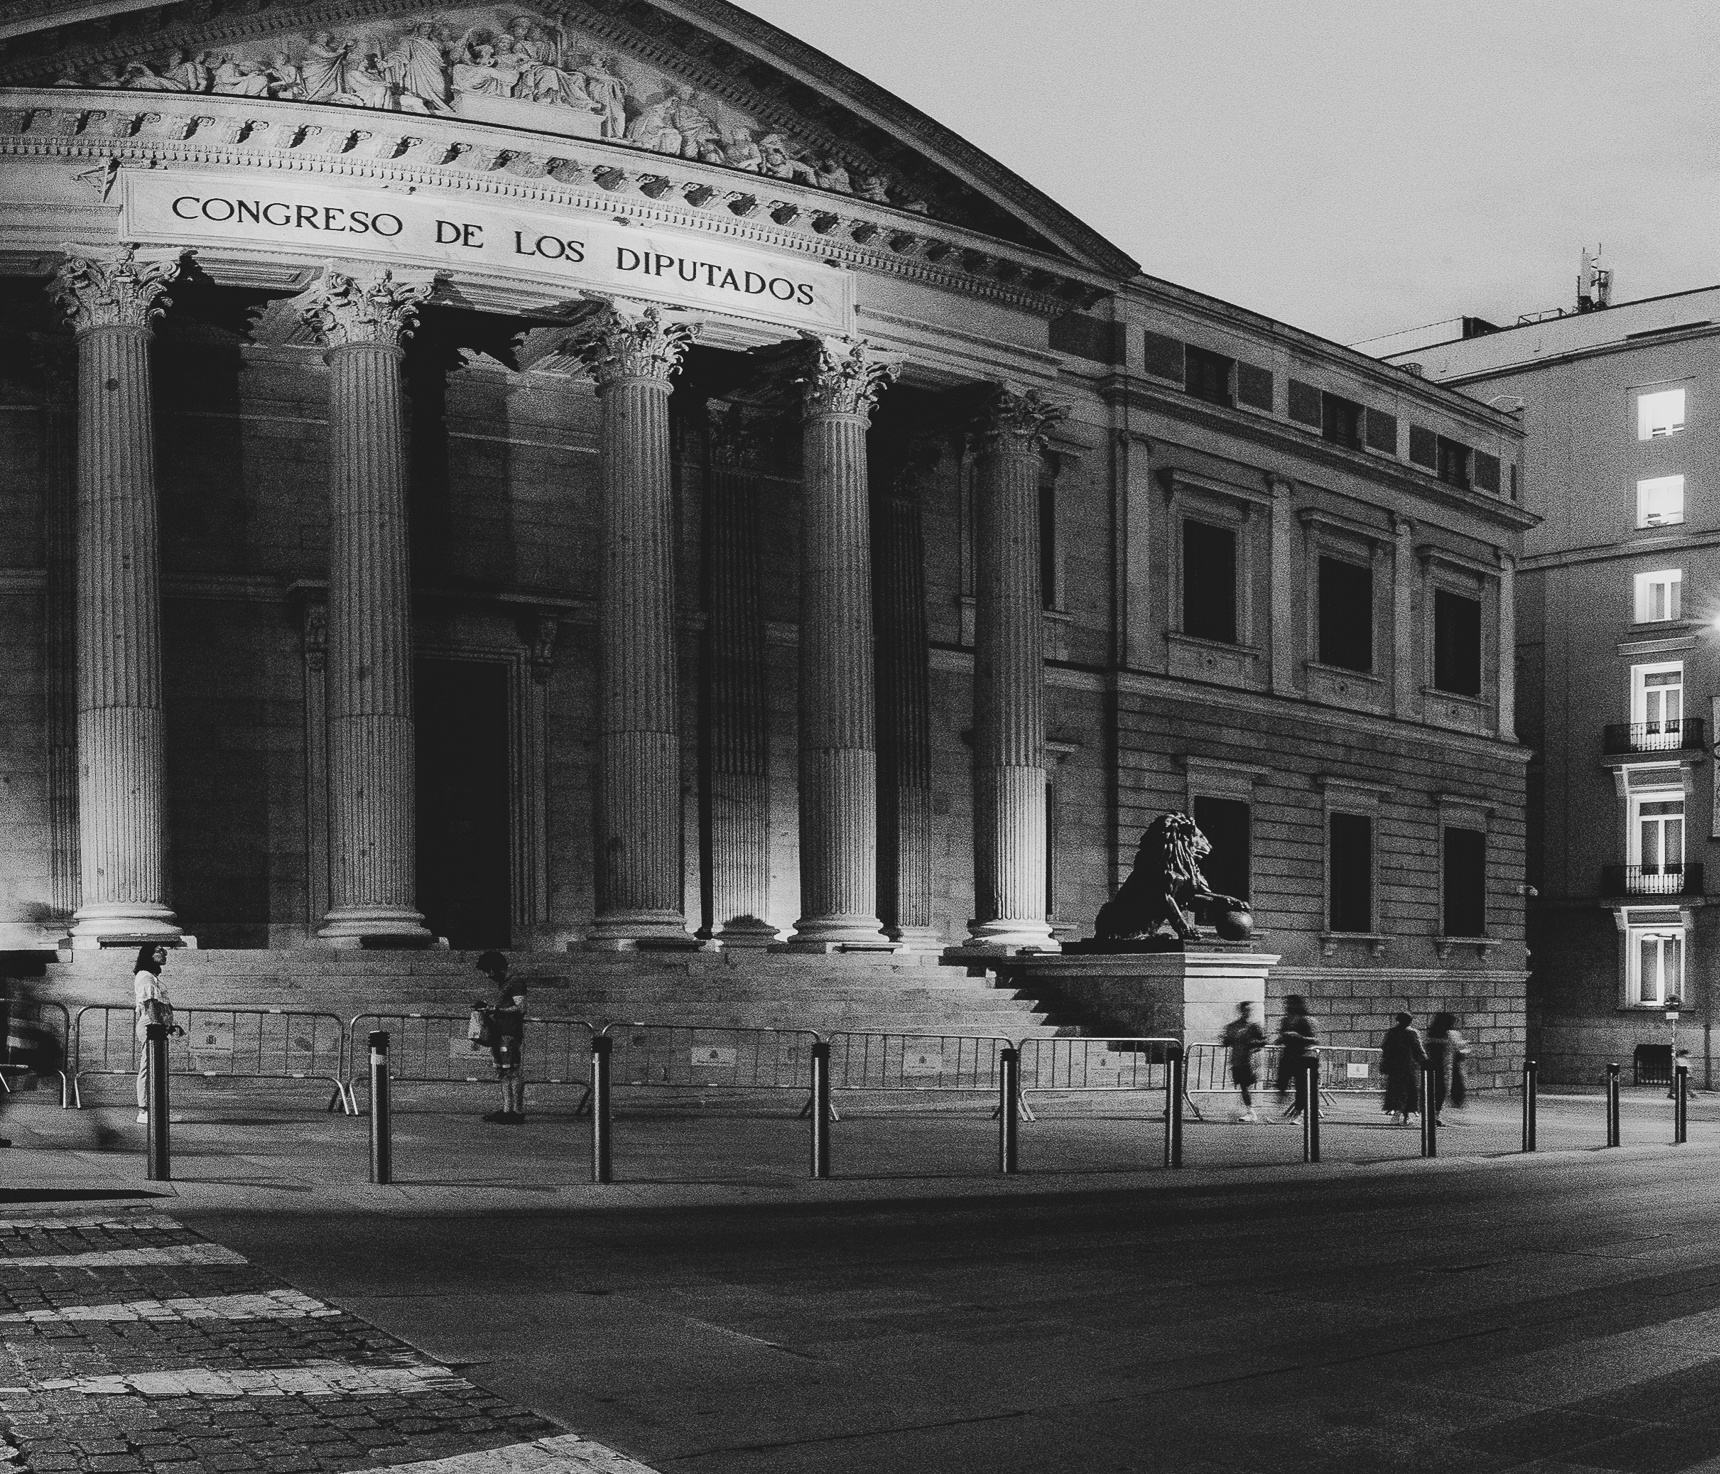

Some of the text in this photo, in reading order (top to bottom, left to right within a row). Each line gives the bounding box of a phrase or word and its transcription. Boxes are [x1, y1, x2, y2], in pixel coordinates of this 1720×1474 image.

[171, 196, 814, 306] CONGRESO DE LOS DIPUTADOS
